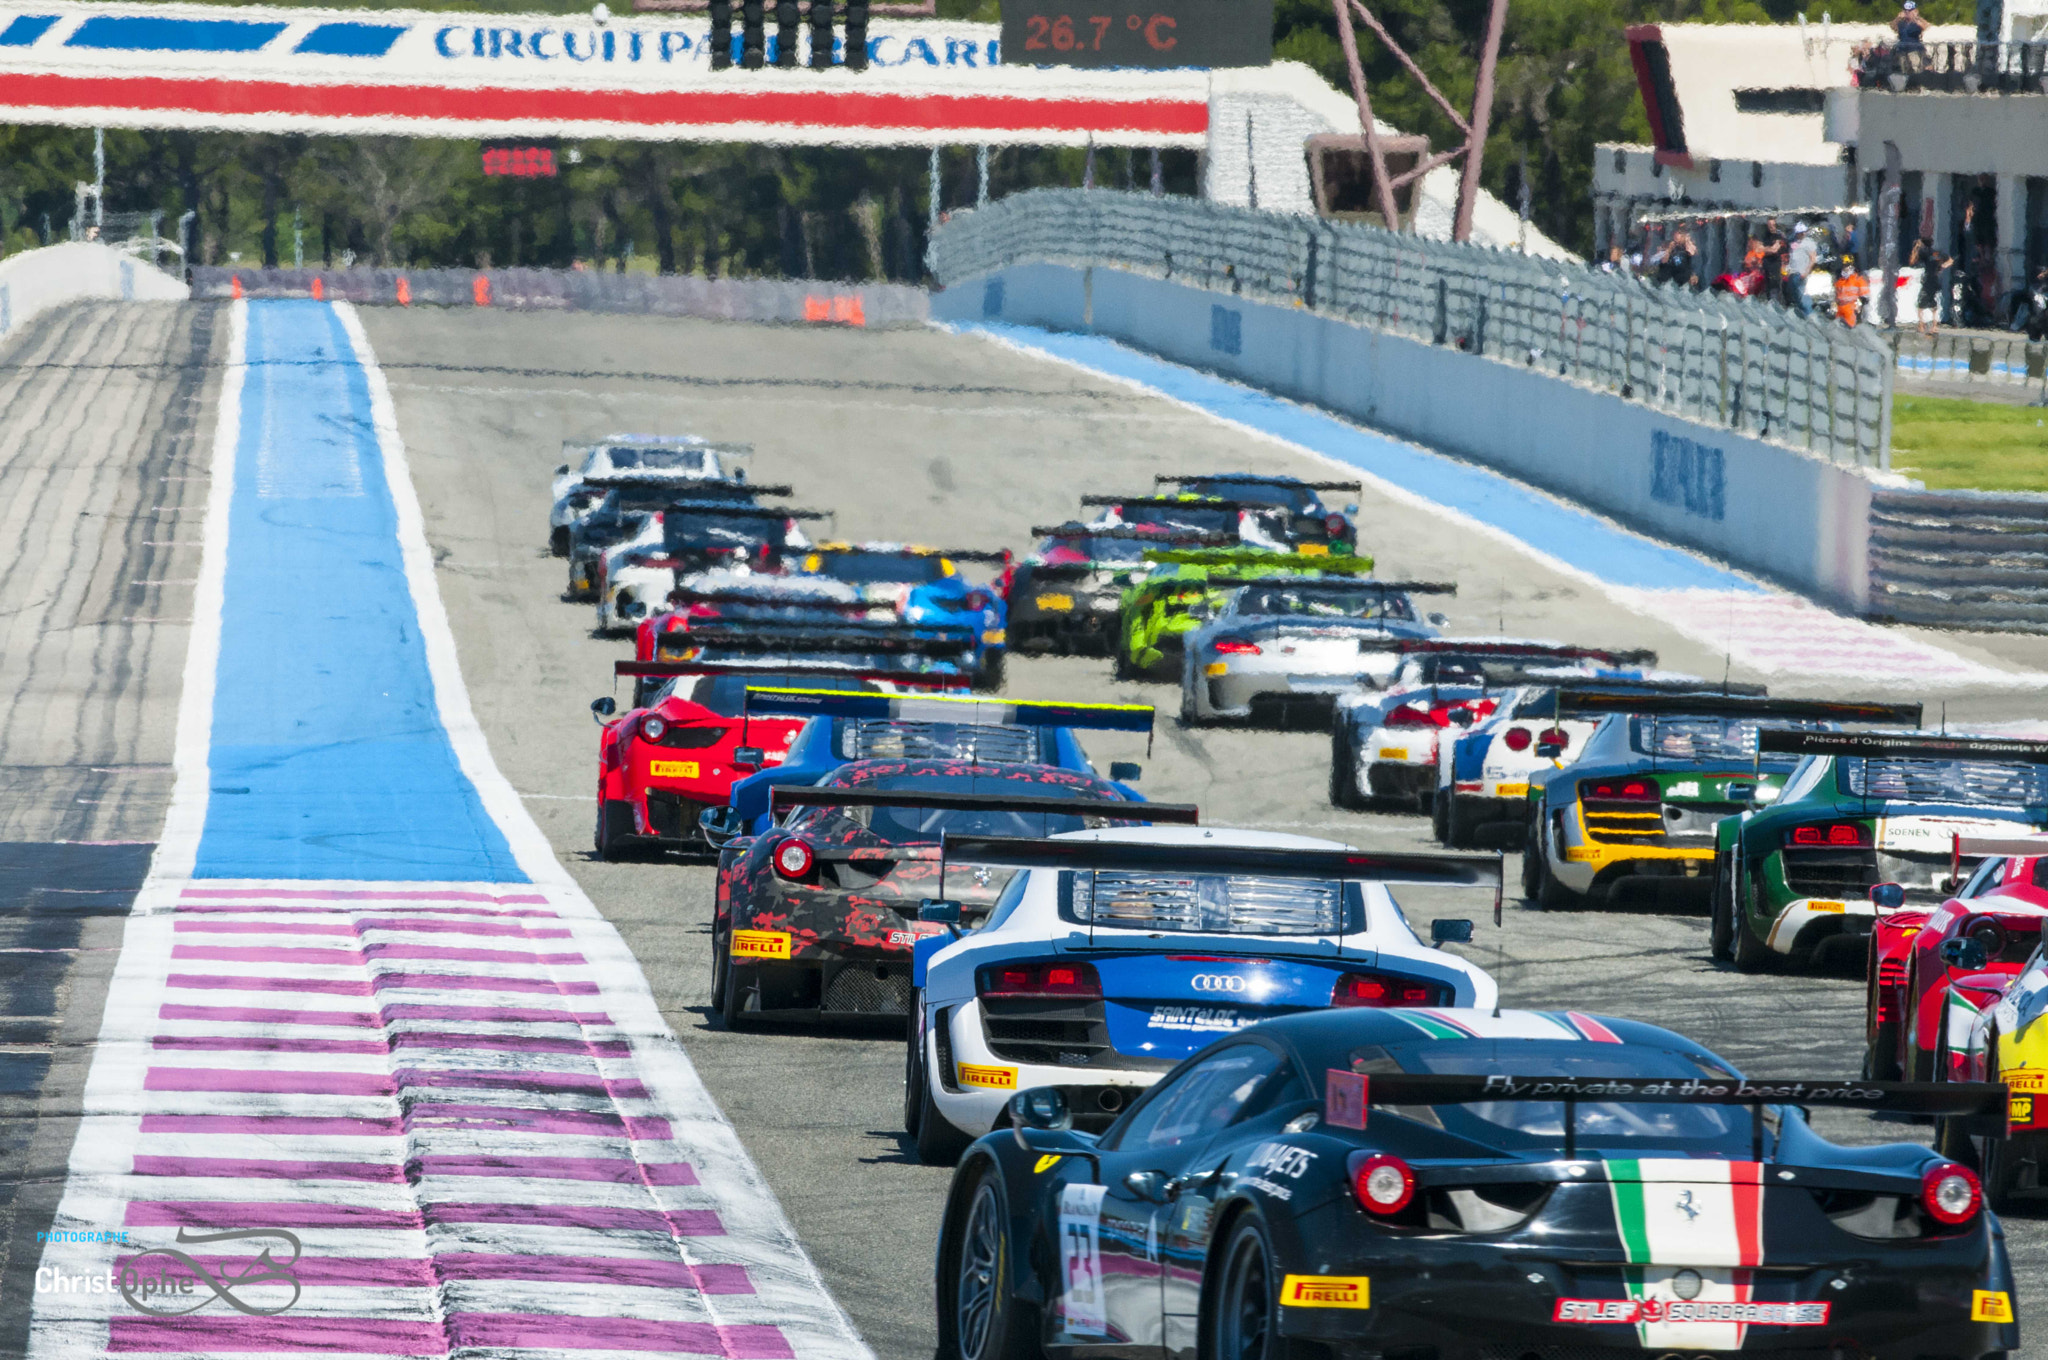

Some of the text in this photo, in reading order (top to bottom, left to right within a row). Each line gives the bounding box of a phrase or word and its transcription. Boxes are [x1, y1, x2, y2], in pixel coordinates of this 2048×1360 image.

[1025, 14, 1178, 51] 26.7 °C
[434, 25, 650, 63] CIRCUIT
[1805, 736, 1847, 744] Pièces
[1849, 737, 1911, 748] d'Origine
[1888, 828, 1931, 837] SOENEN
[733, 935, 784, 953] PIRELLI
[961, 1067, 1011, 1085] PIRELLI
[1482, 1075, 1884, 1099] Fly private at the best price
[2008, 1100, 2032, 1119] MP
[1294, 1282, 1359, 1302] PIRELLI
